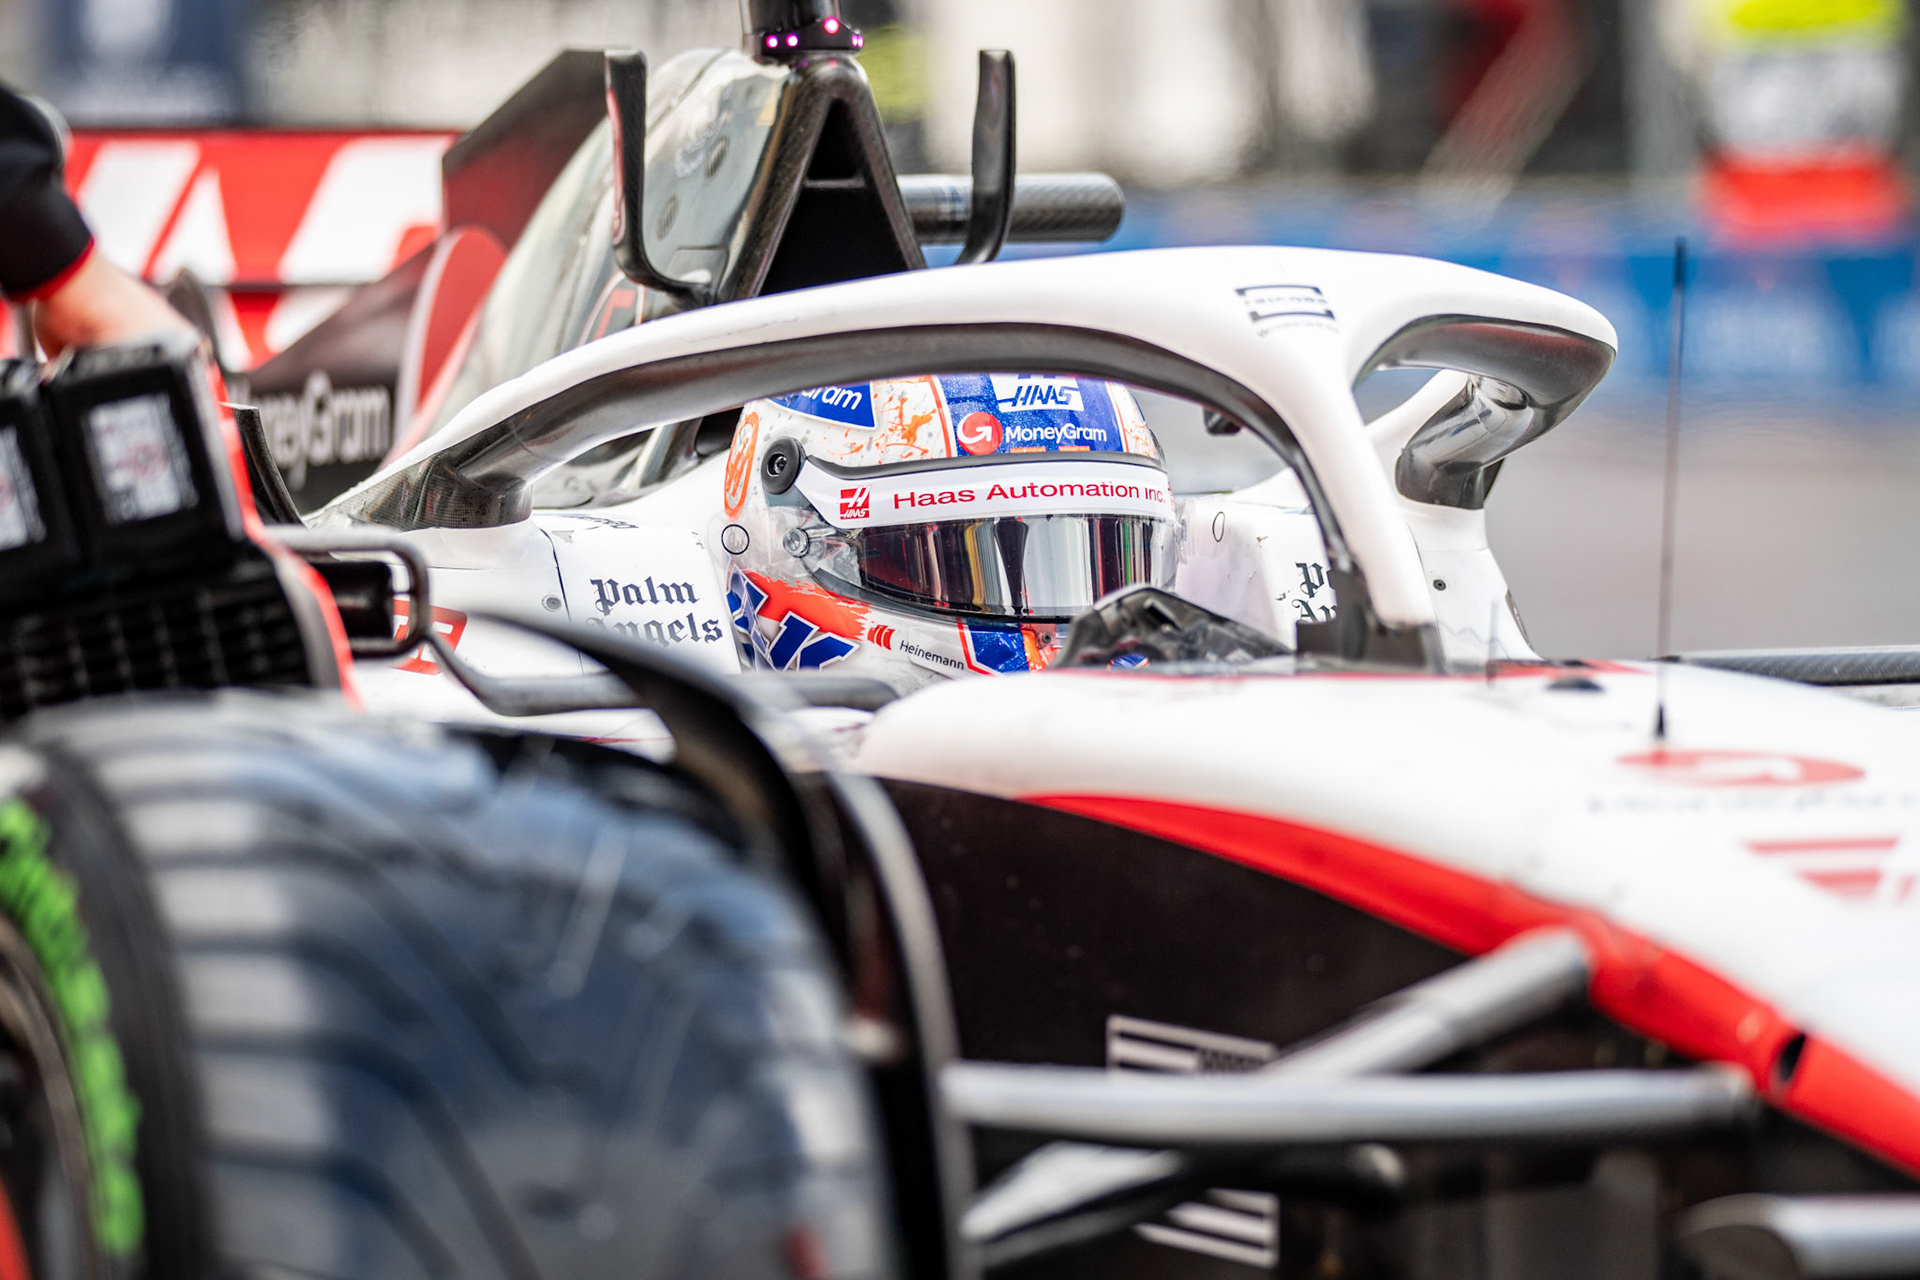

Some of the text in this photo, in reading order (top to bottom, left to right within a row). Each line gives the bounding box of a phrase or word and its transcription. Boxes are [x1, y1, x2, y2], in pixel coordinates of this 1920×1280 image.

[1005, 423, 1107, 444] MoneyGram
[893, 489, 976, 510] Haas
[986, 481, 1140, 501] Automation
[589, 576, 701, 617] Palm
[900, 640, 965, 671] Heinemann
